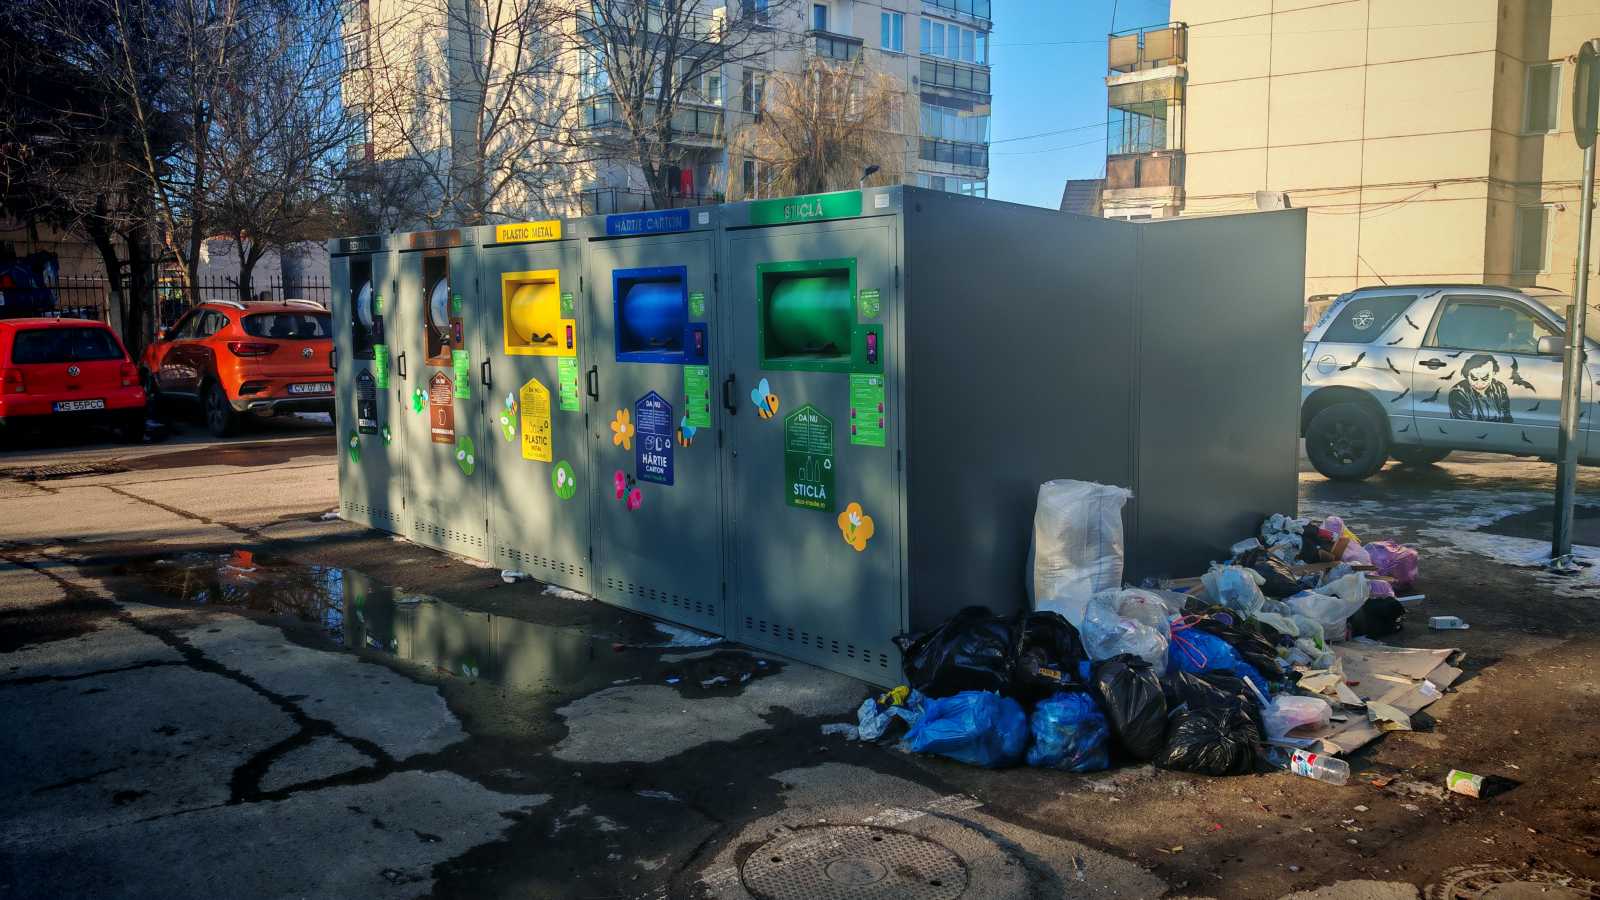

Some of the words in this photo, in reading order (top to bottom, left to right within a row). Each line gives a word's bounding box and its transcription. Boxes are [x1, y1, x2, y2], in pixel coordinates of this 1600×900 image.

[502, 227, 529, 241] PLASTIC
[531, 226, 554, 239] METAL
[525, 434, 547, 446] PLASTIC
[793, 483, 826, 499] STICLĂ
